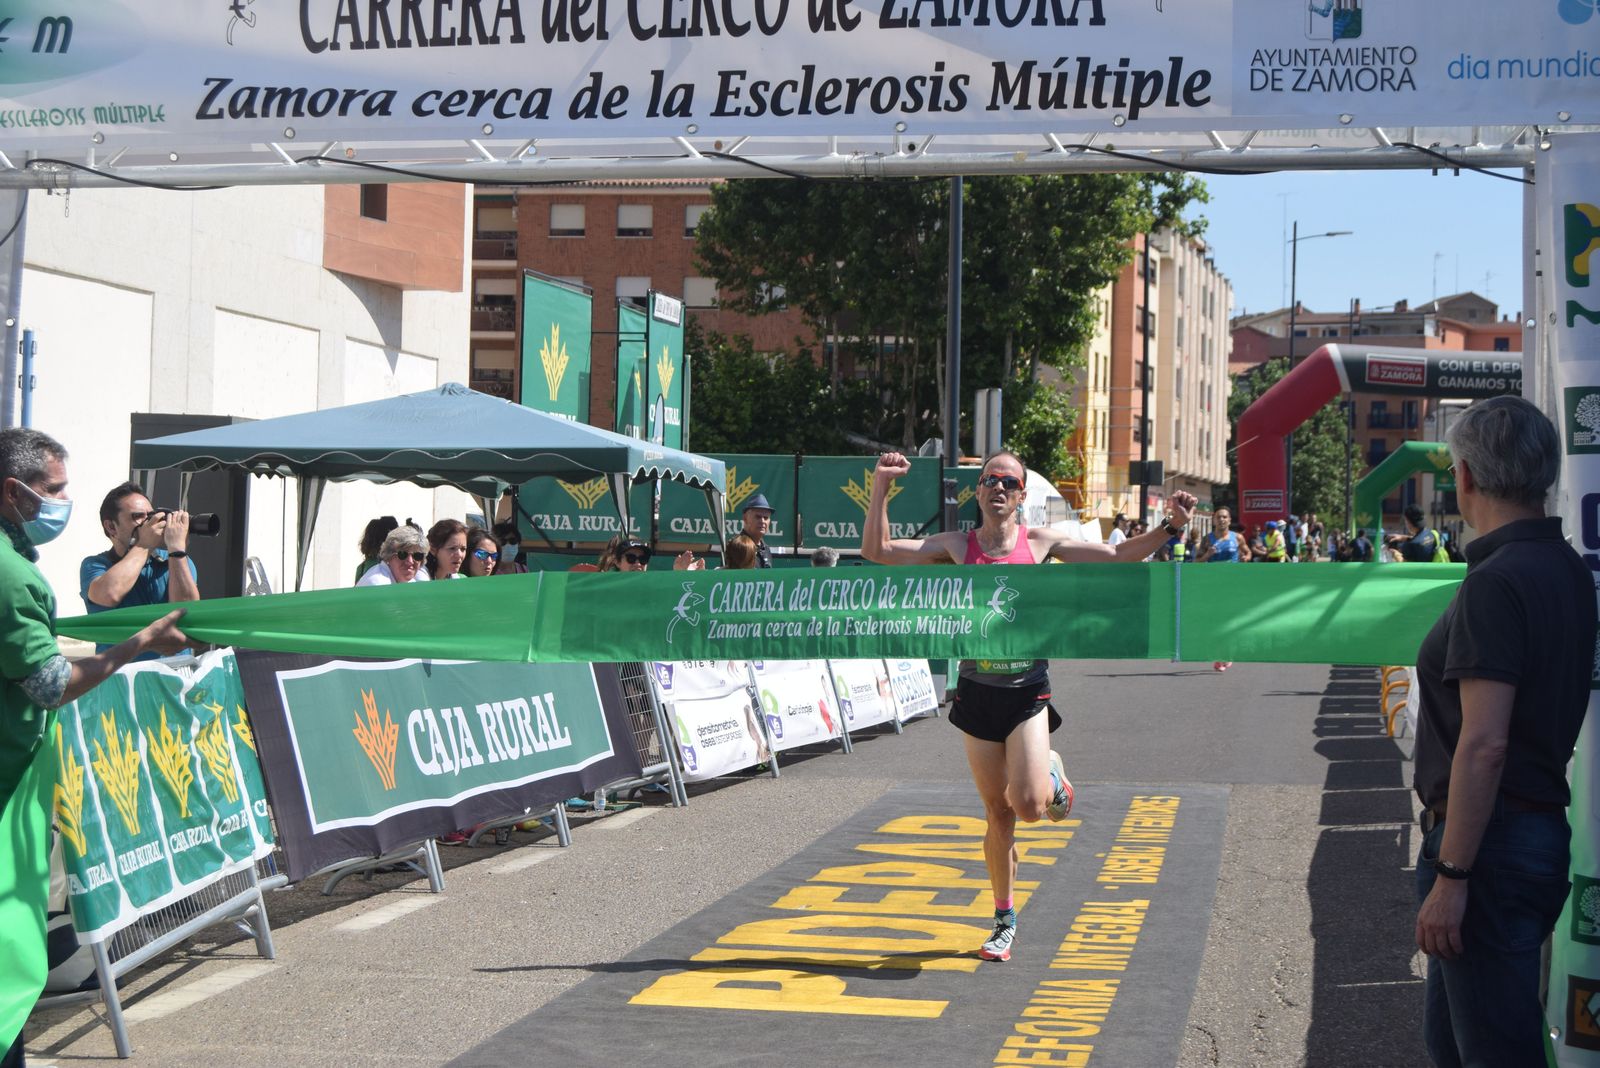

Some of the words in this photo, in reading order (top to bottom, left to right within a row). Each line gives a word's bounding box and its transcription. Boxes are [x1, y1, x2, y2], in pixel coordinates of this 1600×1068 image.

[300, 0, 525, 54] CARRERA
[1251, 46, 1417, 67] AYUNTAMIENTO
[1447, 54, 1489, 80] dia
[195, 77, 397, 120] Zamora
[411, 87, 552, 120] cerca
[568, 72, 629, 120] de
[646, 70, 695, 118] la
[710, 61, 970, 118] Esclerosis
[986, 56, 1212, 120] Múltiple
[1250, 69, 1283, 92] DE
[1292, 68, 1417, 92] ZAMORA
[0, 106, 86, 128] ESCLEROSIS
[93, 102, 166, 125] MÚLTIPLE
[1381, 370, 1422, 381] ZAMORA
[1438, 359, 1469, 371] CON
[1473, 361, 1489, 372] EL
[1492, 362, 1522, 374] DEP
[1438, 376, 1506, 390] GANAMOS
[531, 514, 573, 530] CAJA
[671, 517, 715, 533] CAJA
[725, 519, 783, 536] RUL
[815, 522, 859, 538] CAJA
[709, 581, 784, 614] CARRERA
[789, 579, 815, 611] del
[819, 577, 875, 611] CERCO
[878, 577, 897, 609] de
[902, 577, 974, 610] ZAMORA
[708, 620, 761, 639] Zamora
[766, 621, 802, 637] cerca
[807, 616, 822, 635] de
[827, 616, 840, 635] la
[844, 615, 911, 636] Esclerosis
[915, 614, 973, 639] Múltiple
[408, 706, 484, 776] CAJA
[476, 692, 572, 764] RURAL
[1049, 899, 1150, 971] INTEGRAL
[992, 979, 1121, 1068] EFORMA
